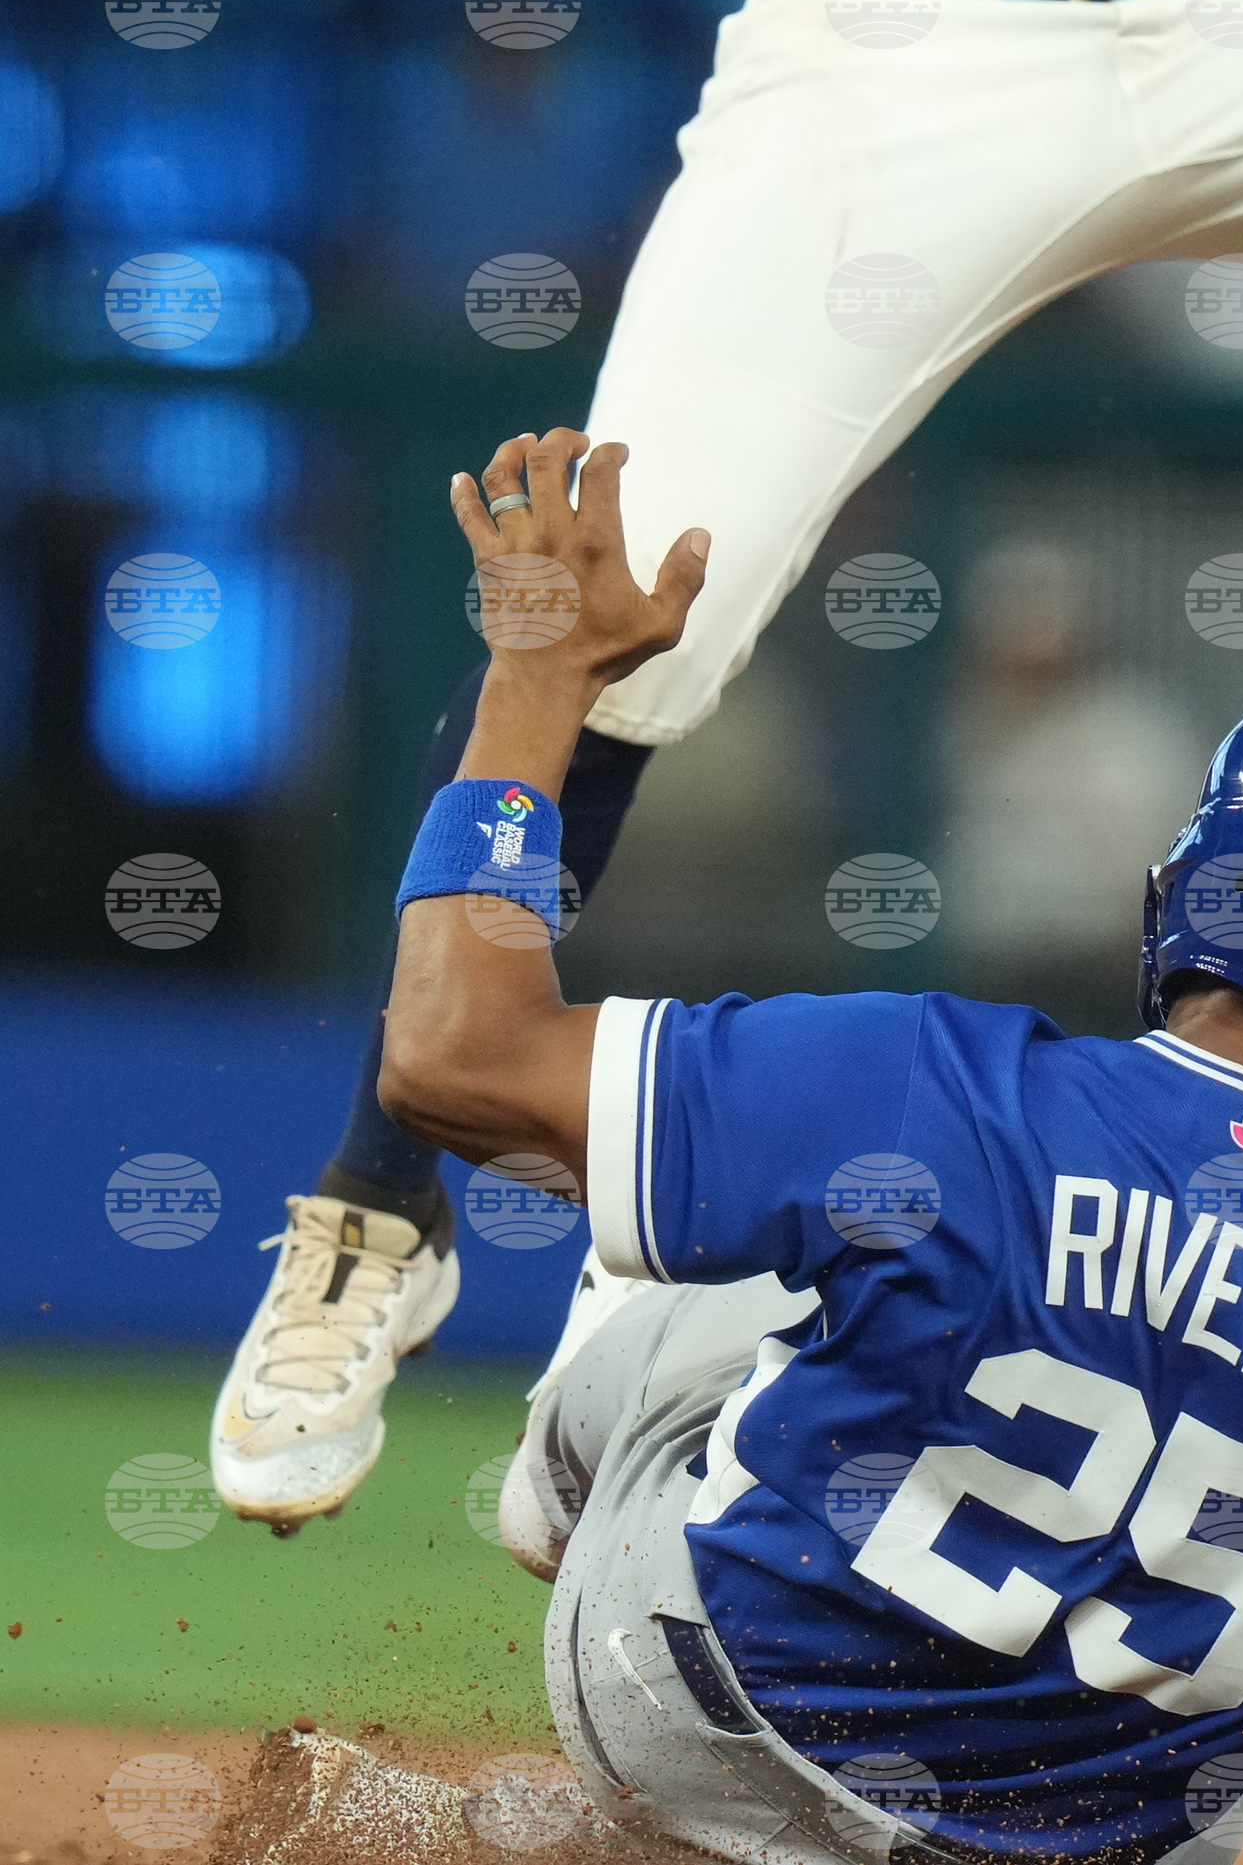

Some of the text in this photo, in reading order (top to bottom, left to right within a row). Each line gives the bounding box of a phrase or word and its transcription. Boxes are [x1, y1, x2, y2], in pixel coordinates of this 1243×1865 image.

[491, 820, 507, 865] CLASSIC
[500, 822, 517, 872] BASEBALL
[510, 827, 526, 864] WORLD
